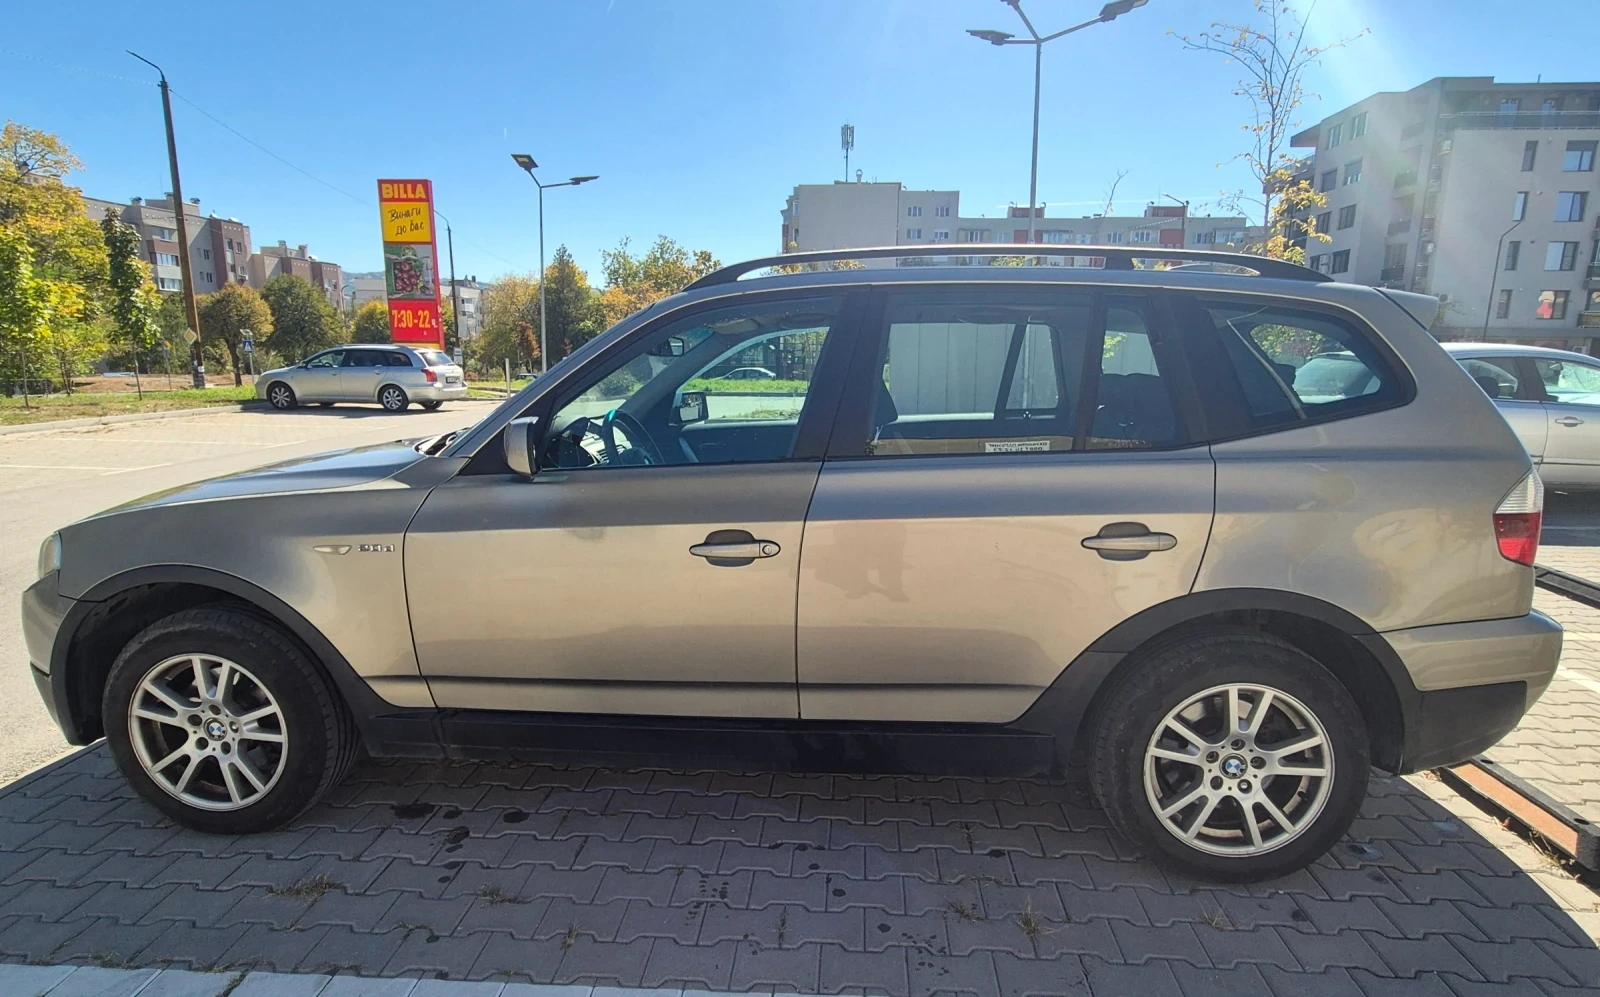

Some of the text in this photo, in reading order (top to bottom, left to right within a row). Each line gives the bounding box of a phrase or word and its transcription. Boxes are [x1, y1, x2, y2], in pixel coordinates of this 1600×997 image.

[381, 183, 427, 199] BILLA
[387, 207, 421, 223] Винаги
[395, 225, 407, 237] до
[391, 309, 431, 328] 7:30-22
